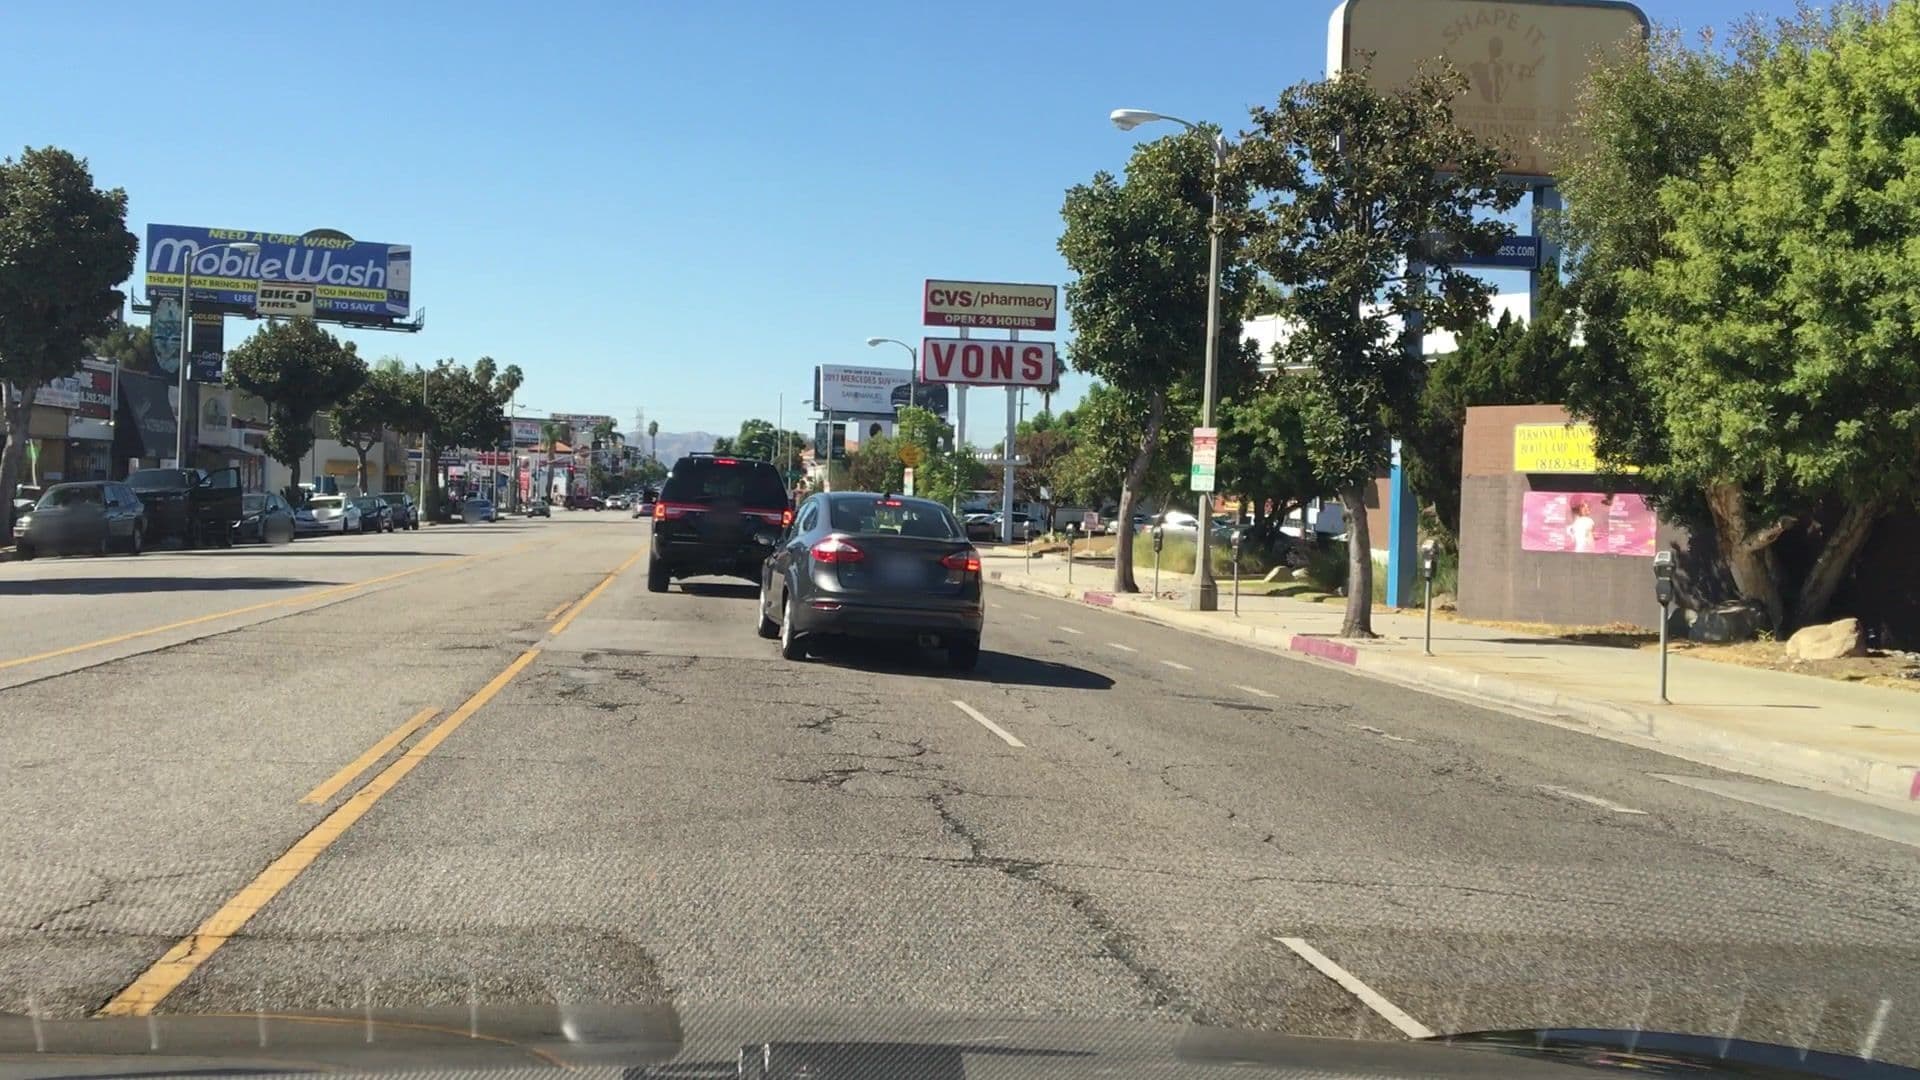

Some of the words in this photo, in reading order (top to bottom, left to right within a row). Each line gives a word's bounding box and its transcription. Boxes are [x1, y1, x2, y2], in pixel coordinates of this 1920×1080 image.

[1442, 8, 1521, 45] SHAPE
[1525, 23, 1546, 48] IT
[208, 228, 249, 242] NEED
[252, 233, 263, 243] A
[268, 233, 298, 247] CAR
[303, 236, 356, 250] WASH?
[148, 275, 166, 284] THE
[209, 280, 240, 290] BRINGS
[261, 289, 295, 300] BIG
[318, 287, 336, 297] YOU
[339, 290, 347, 298] IN
[348, 290, 385, 301] MINUTES
[929, 288, 1053, 310] CVS/pharmacy
[234, 293, 254, 303] USE
[335, 301, 349, 311] TO
[350, 302, 376, 313] SAVE
[260, 300, 297, 310] TIRES
[944, 314, 976, 325] OPEN
[979, 315, 994, 326] 24
[996, 316, 1037, 328] HOURS
[930, 343, 1044, 381] VONS
[841, 373, 877, 385] MERCEDES
[878, 376, 892, 386] SUV
[1519, 428, 1556, 440] PERSONAL
[1520, 442, 1541, 455] BOOT
[1544, 442, 1569, 456] CAMP
